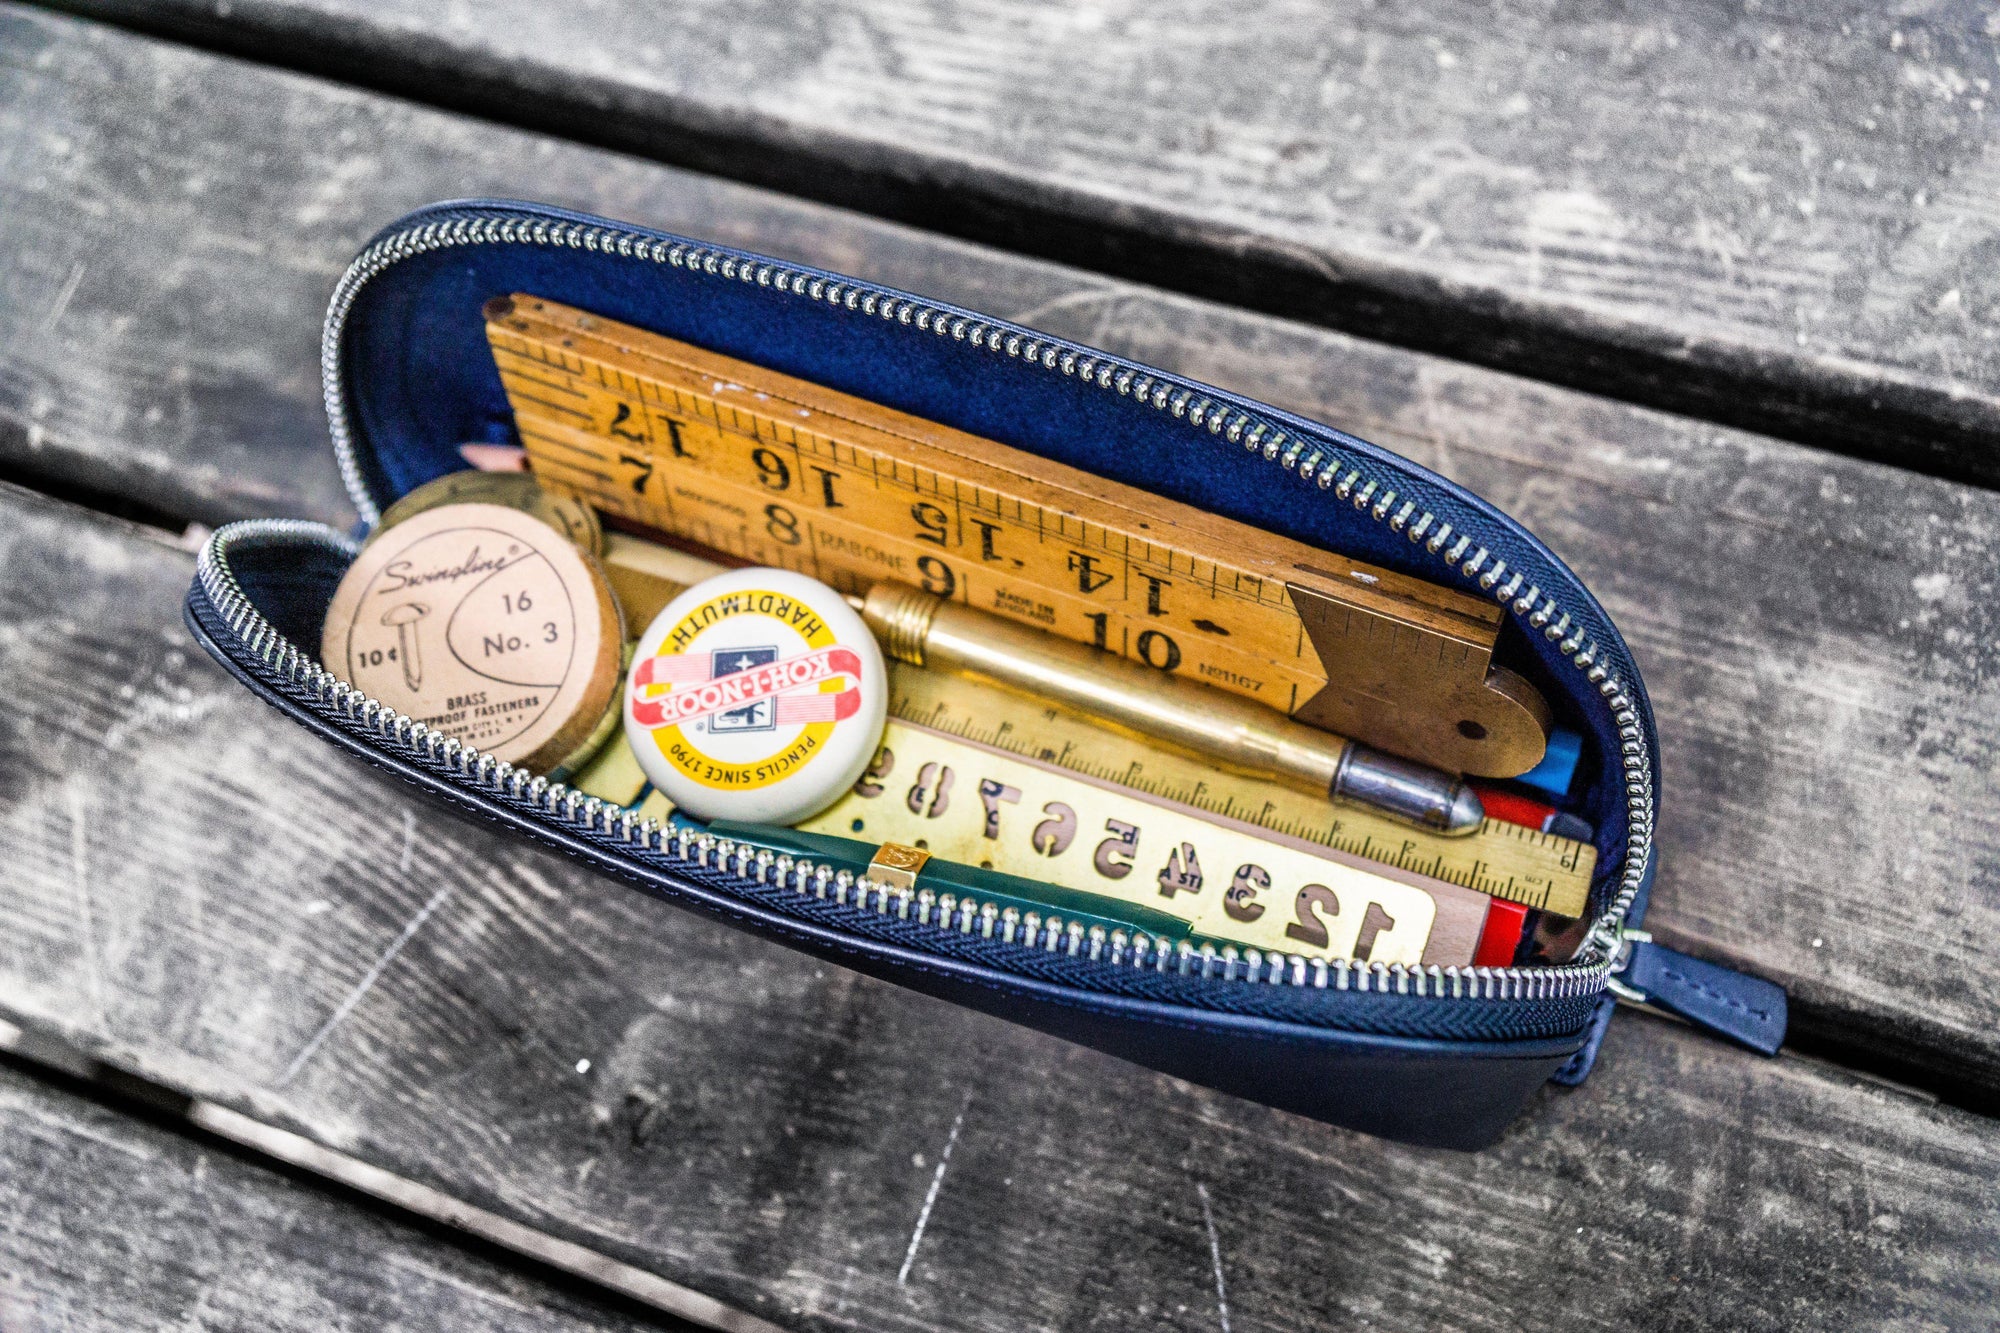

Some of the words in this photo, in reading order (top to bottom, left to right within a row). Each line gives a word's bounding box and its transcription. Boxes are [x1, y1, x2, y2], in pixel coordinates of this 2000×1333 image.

[619, 453, 653, 495] 7
[765, 502, 801, 547] 8
[916, 555, 956, 599] 9
[1083, 610, 1182, 673] 10
[819, 529, 907, 568] RABONE
[378, 546, 505, 594] Swingline
[501, 589, 533, 615] 16
[671, 593, 823, 643] HARDTMUTH
[482, 632, 530, 658] No.
[542, 621, 559, 644] 3
[447, 691, 488, 711] BRASS
[658, 653, 833, 722] KOH-I-NOOR
[474, 696, 540, 718] FASTENERS
[670, 742, 702, 773] 1790
[704, 765, 751, 784] SINCE
[756, 735, 817, 782] PENCILS
